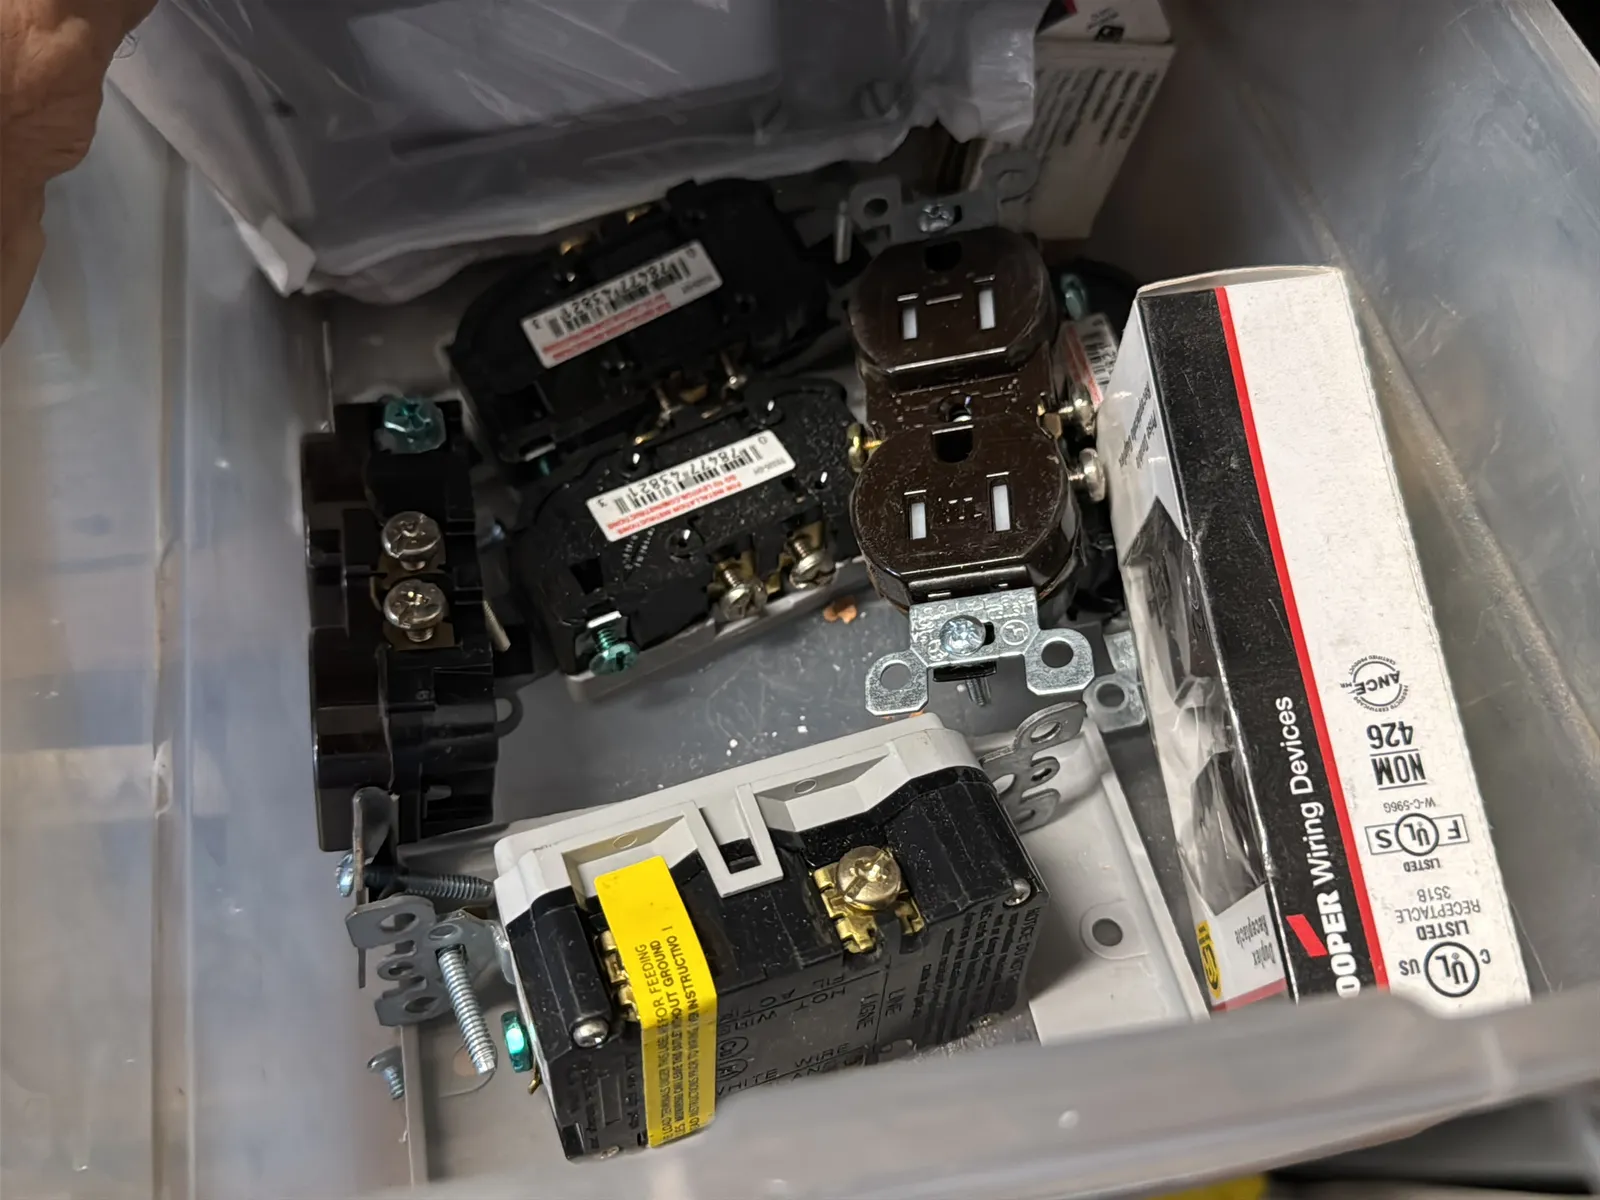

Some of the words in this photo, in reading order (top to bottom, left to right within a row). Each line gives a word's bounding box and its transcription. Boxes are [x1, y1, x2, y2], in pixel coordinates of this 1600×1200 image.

[690, 448, 741, 474] 78477
[628, 471, 682, 499] 43821
[1348, 670, 1400, 696] ANCE
[1276, 696, 1314, 795] Devices
[1366, 721, 1414, 750] 426
[1371, 753, 1426, 786] NOM
[1383, 797, 1437, 814] W-C-596G
[1374, 828, 1393, 849] S
[1446, 819, 1462, 840] F
[1300, 800, 1335, 887] Wiring
[1402, 857, 1441, 873] LISTED
[1394, 898, 1481, 924] RECEPTACLE
[1415, 919, 1470, 941] LISTED
[1316, 889, 1361, 999] OOPER
[1479, 948, 1492, 965] C
[634, 944, 662, 994] FEEDING
[650, 940, 674, 987] GROUND
[666, 935, 699, 1011] INSTRUCTIVO
[1398, 957, 1421, 977] US
[795, 986, 846, 1012] HOT
